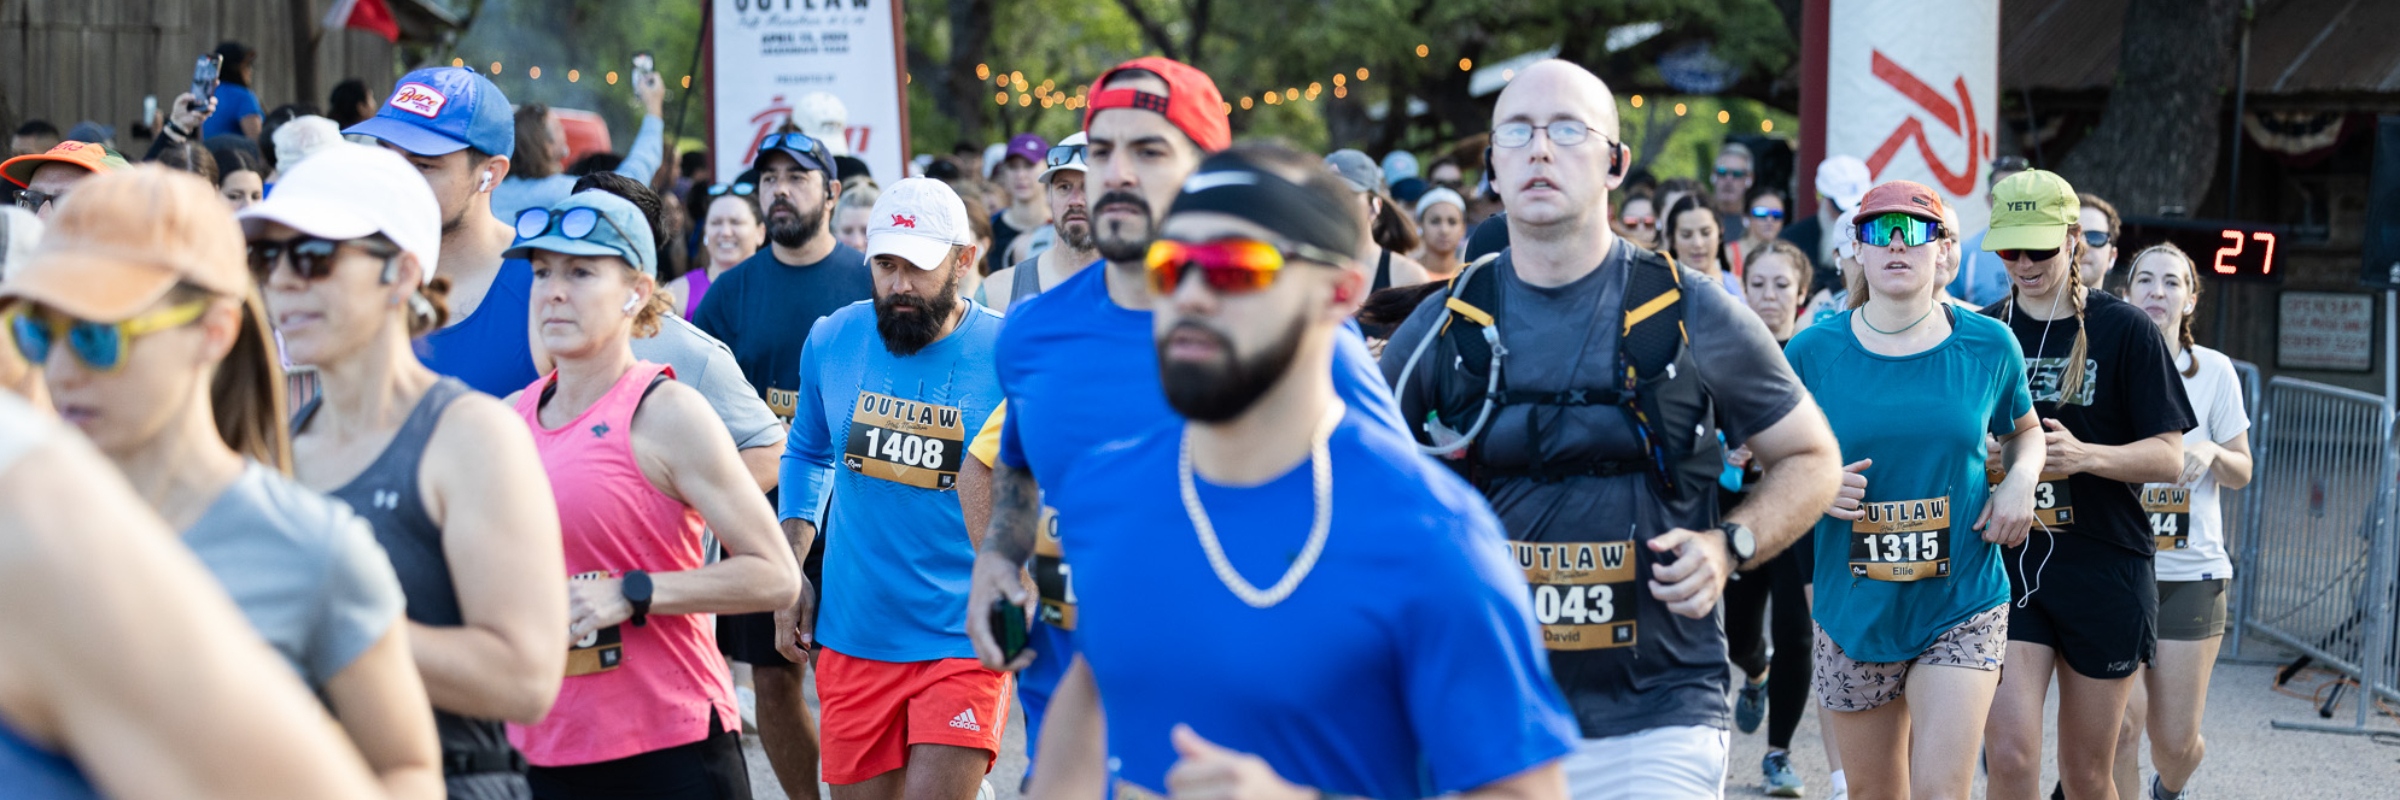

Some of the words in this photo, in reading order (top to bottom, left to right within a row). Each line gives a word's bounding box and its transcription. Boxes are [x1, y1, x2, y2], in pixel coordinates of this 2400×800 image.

[2007, 201, 2036, 212] YETI
[2214, 229, 2275, 275] 27
[863, 394, 958, 428] OUTLAW
[866, 427, 944, 470] 1408
[1864, 531, 1939, 562] 1315
[1892, 566, 1914, 576] Ellie
[1534, 584, 1614, 625] 043
[1544, 630, 1580, 642] David
[949, 719, 980, 732] adidas
